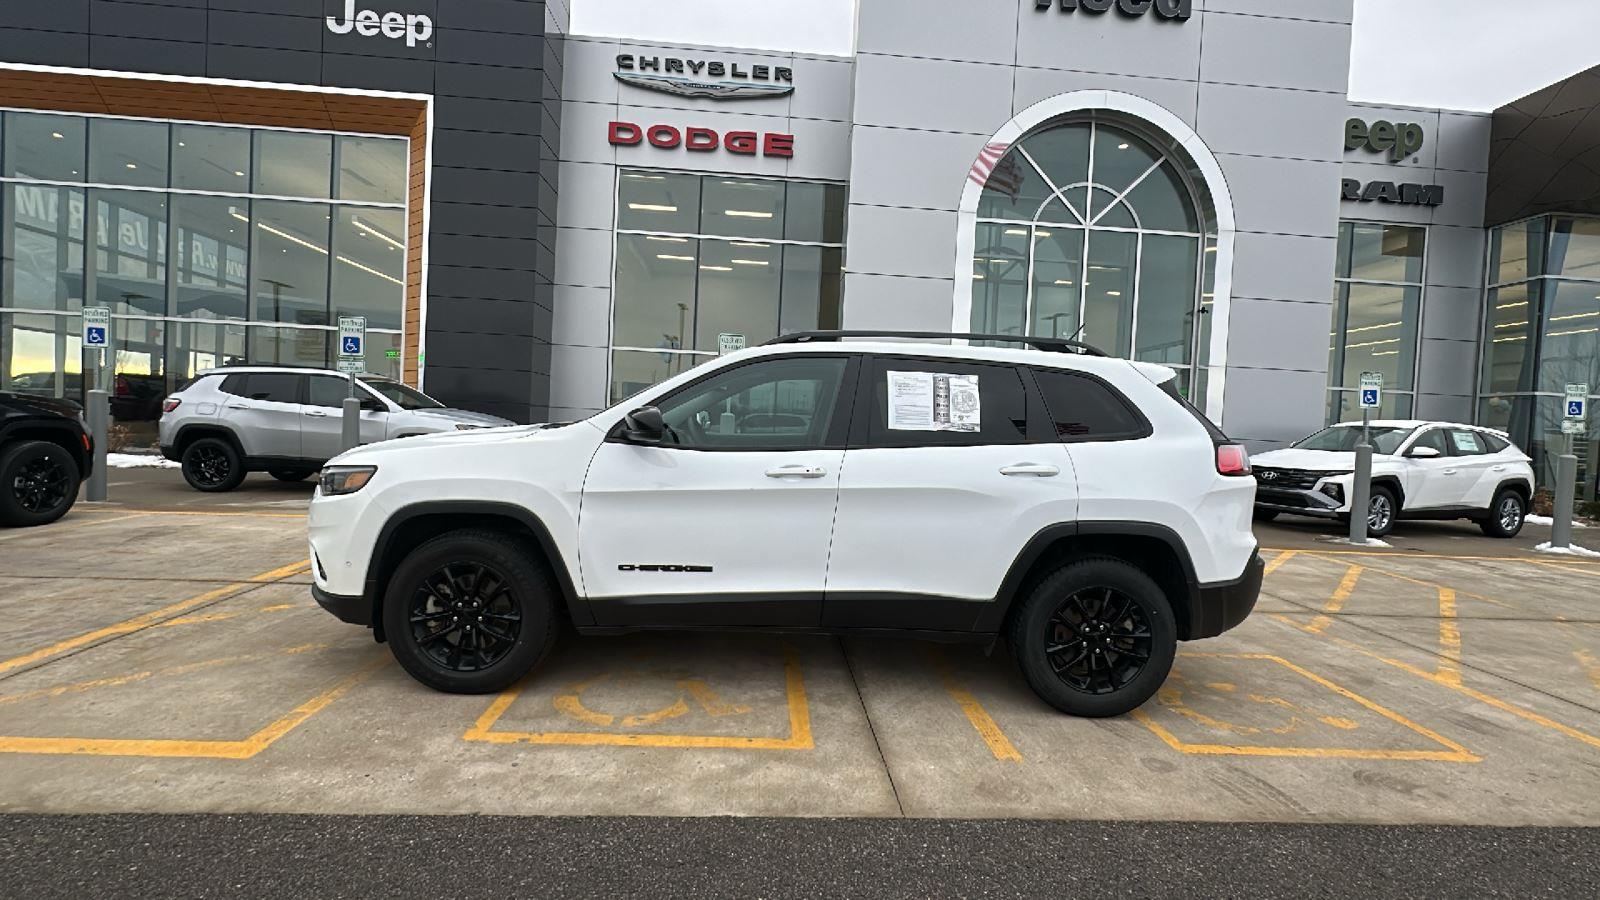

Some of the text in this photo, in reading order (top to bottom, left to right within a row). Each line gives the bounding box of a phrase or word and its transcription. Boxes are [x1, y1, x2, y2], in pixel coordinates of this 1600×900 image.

[327, 0, 433, 47] Jeep
[616, 54, 792, 81] CHRYSLER
[608, 121, 794, 158] DODGE
[1344, 117, 1424, 163] eep
[1340, 178, 1444, 206] RAM
